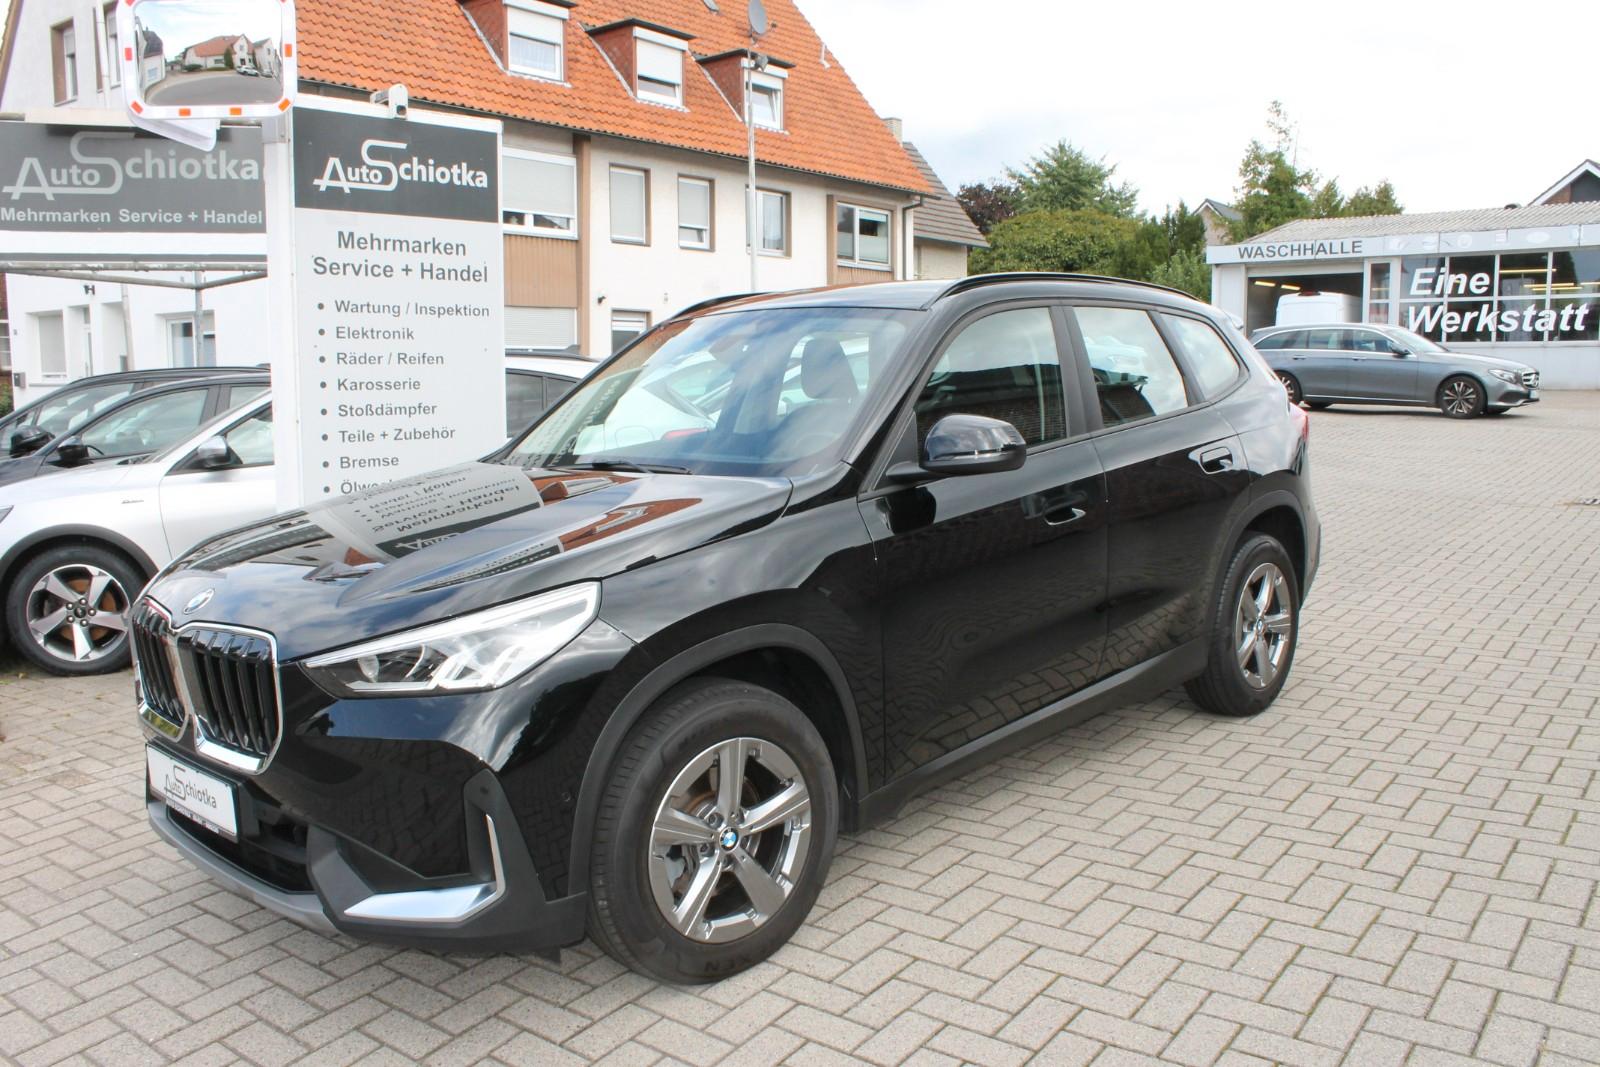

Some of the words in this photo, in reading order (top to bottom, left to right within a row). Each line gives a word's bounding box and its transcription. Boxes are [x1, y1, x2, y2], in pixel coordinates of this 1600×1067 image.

[0, 208, 111, 222] Mehrmarken
[118, 209, 182, 223] Service
[188, 211, 198, 221] +
[203, 210, 262, 224] Handel
[337, 231, 466, 256] Mehrmarken
[1238, 240, 1363, 260] WASCHHALLE
[313, 257, 394, 277] Service
[401, 264, 412, 276] +
[420, 262, 487, 282] Handel
[1410, 267, 1490, 296] Eine
[334, 300, 400, 317] Wartung
[415, 302, 489, 318] Inspektion
[1408, 303, 1589, 333] Werkstatt
[336, 326, 414, 340] Elektronik
[336, 352, 384, 365] Räder
[397, 352, 444, 365] Reifen
[337, 377, 421, 391] Karosserie
[338, 403, 437, 418] Stoßdämpfer
[339, 430, 375, 443] Teile
[380, 431, 388, 440] +
[394, 426, 456, 441] Zubehör
[340, 455, 399, 469] Bremse
